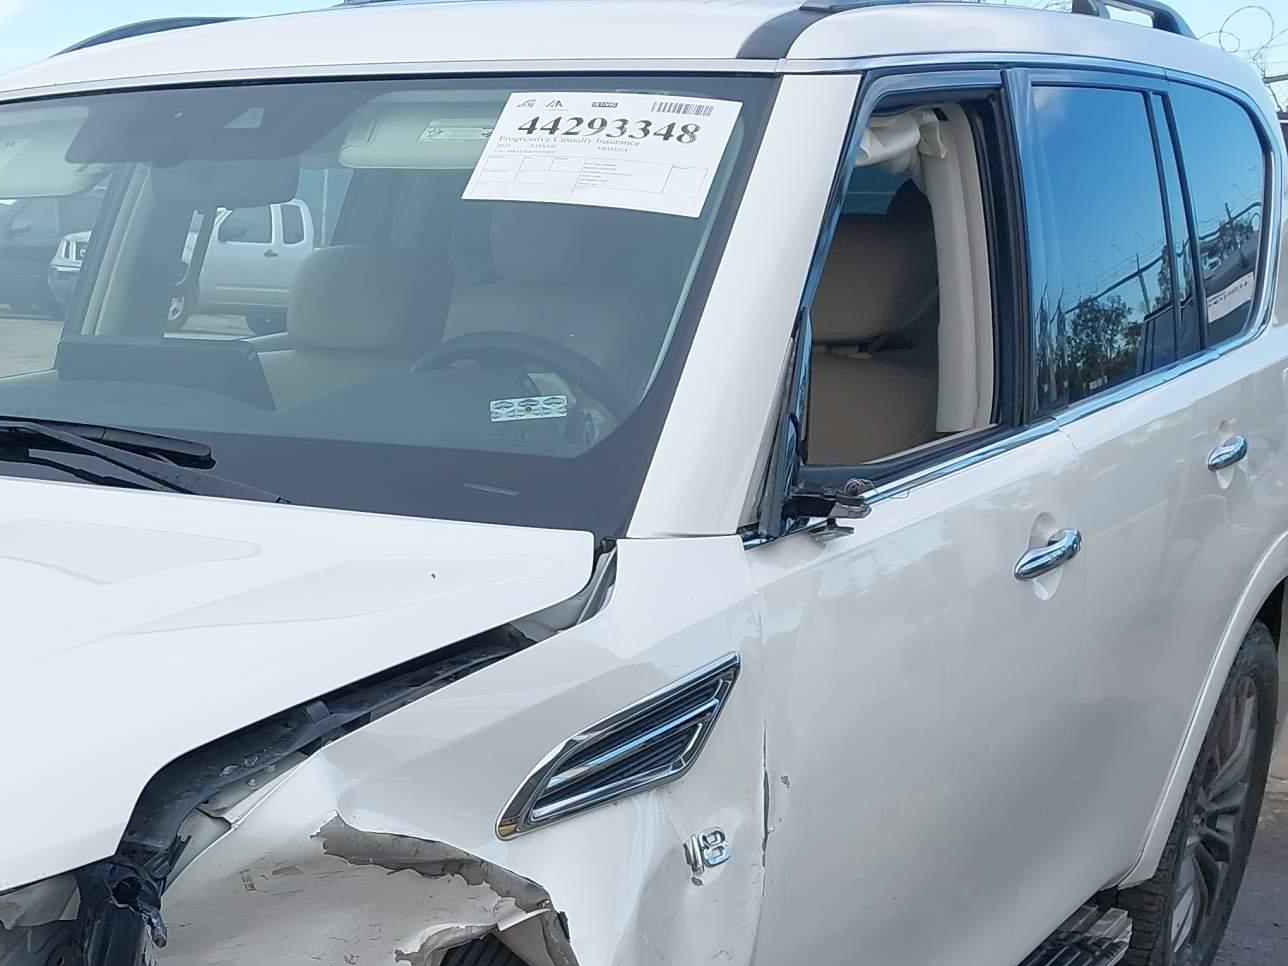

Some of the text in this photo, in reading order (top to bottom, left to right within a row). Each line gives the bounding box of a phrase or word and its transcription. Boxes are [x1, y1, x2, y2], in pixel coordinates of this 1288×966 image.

[517, 115, 701, 144] 44293348
[498, 135, 641, 147] Progressive Casualty Insurance
